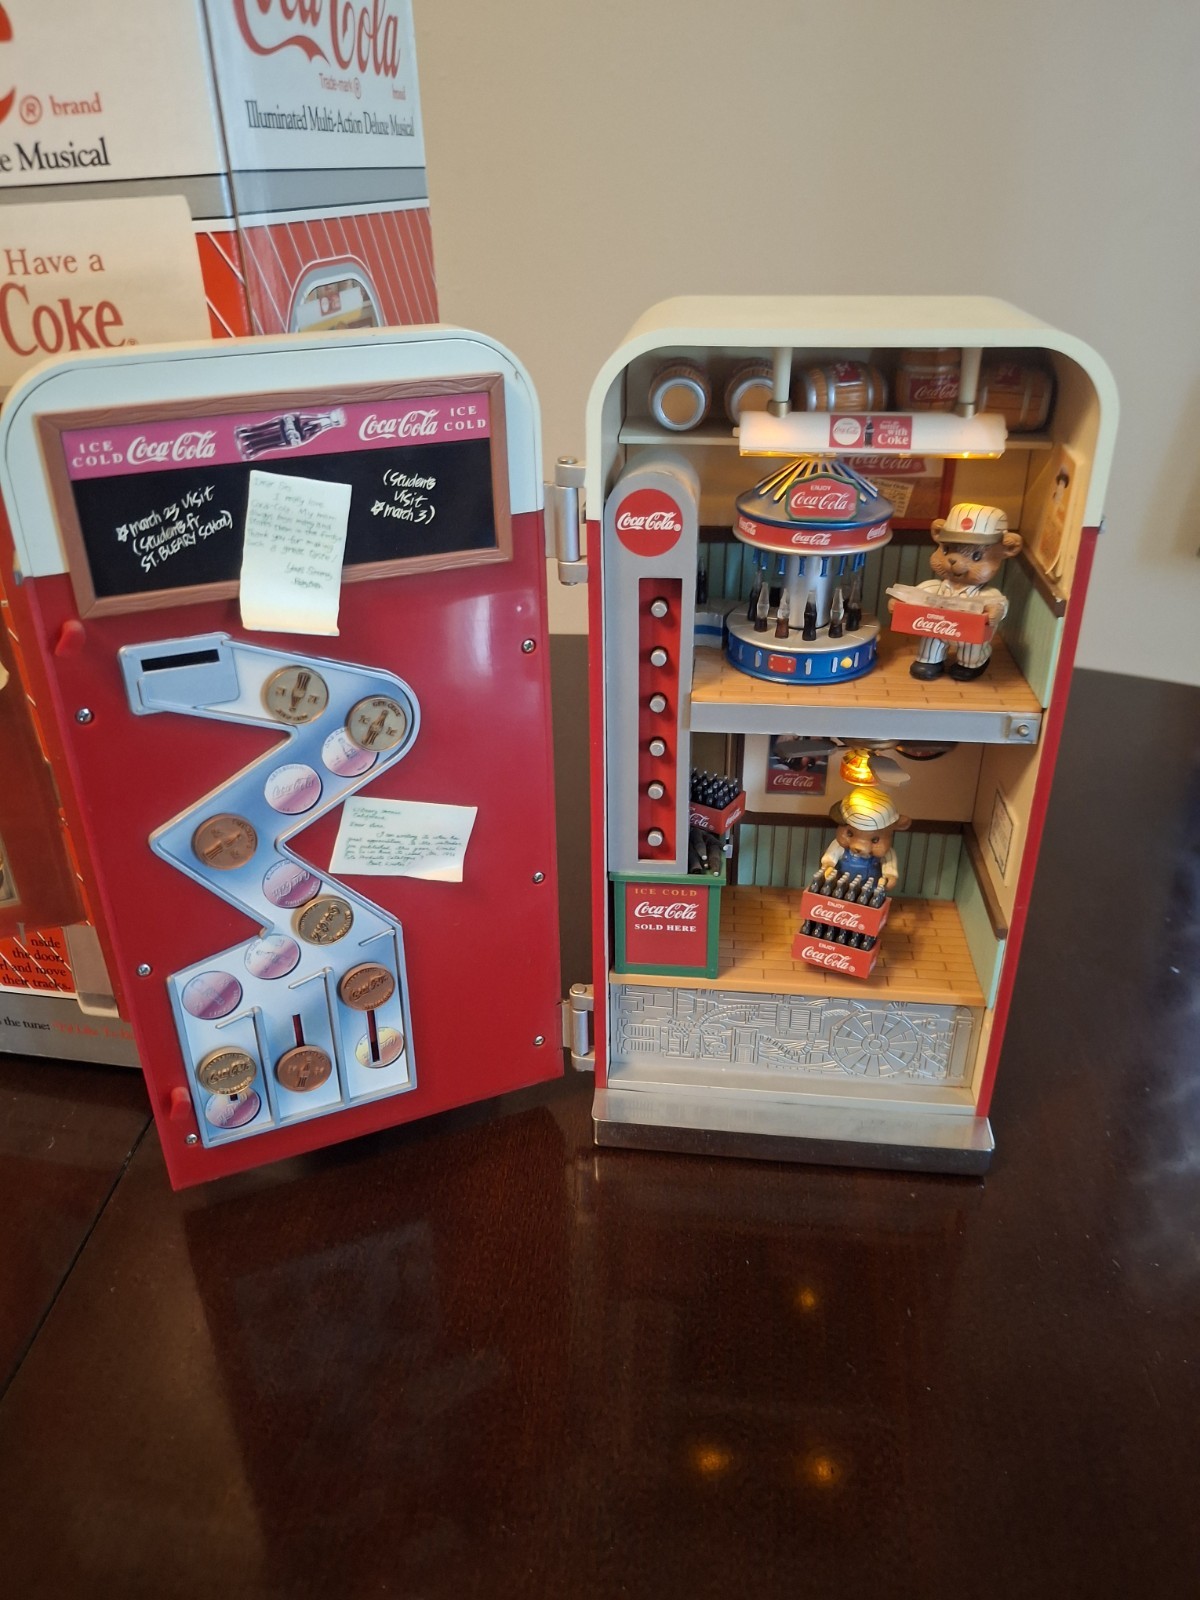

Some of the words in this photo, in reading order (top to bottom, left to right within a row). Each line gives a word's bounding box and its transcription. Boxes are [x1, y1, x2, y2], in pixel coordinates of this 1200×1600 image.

[48, 91, 103, 116] brand
[244, 99, 308, 131] Illuminated
[389, 114, 415, 137] Musical
[14, 136, 111, 172] Musical
[4, 248, 79, 276] Have
[88, 253, 105, 272] a
[0, 282, 124, 357] Coke
[450, 405, 477, 417] ICE
[358, 408, 440, 441] Coca-Cola
[443, 419, 487, 432] COLD
[887, 428, 908, 436] with
[79, 440, 113, 454] ICE
[126, 430, 216, 465] Coca-Cola
[877, 433, 909, 445] Coke
[72, 453, 123, 468] COLD
[791, 491, 850, 510] Coca-Cola
[617, 512, 677, 530] Coca-Cola
[791, 532, 832, 546] Coca-Cola
[912, 617, 959, 636] Coca-Cola
[662, 889, 697, 897] COLD
[634, 901, 700, 920] Coca-Cola
[810, 904, 861, 928] Coca-Cola
[634, 923, 663, 931] SOLD
[666, 924, 697, 932] HERE
[12, 947, 30, 959] the
[801, 945, 852, 970] Coca-Cola
[11, 963, 32, 973] and
[35, 965, 67, 976] move
[3, 974, 28, 985] their
[33, 978, 72, 990] tracks.
[4, 1017, 21, 1027] the
[23, 1020, 51, 1031] tune:
